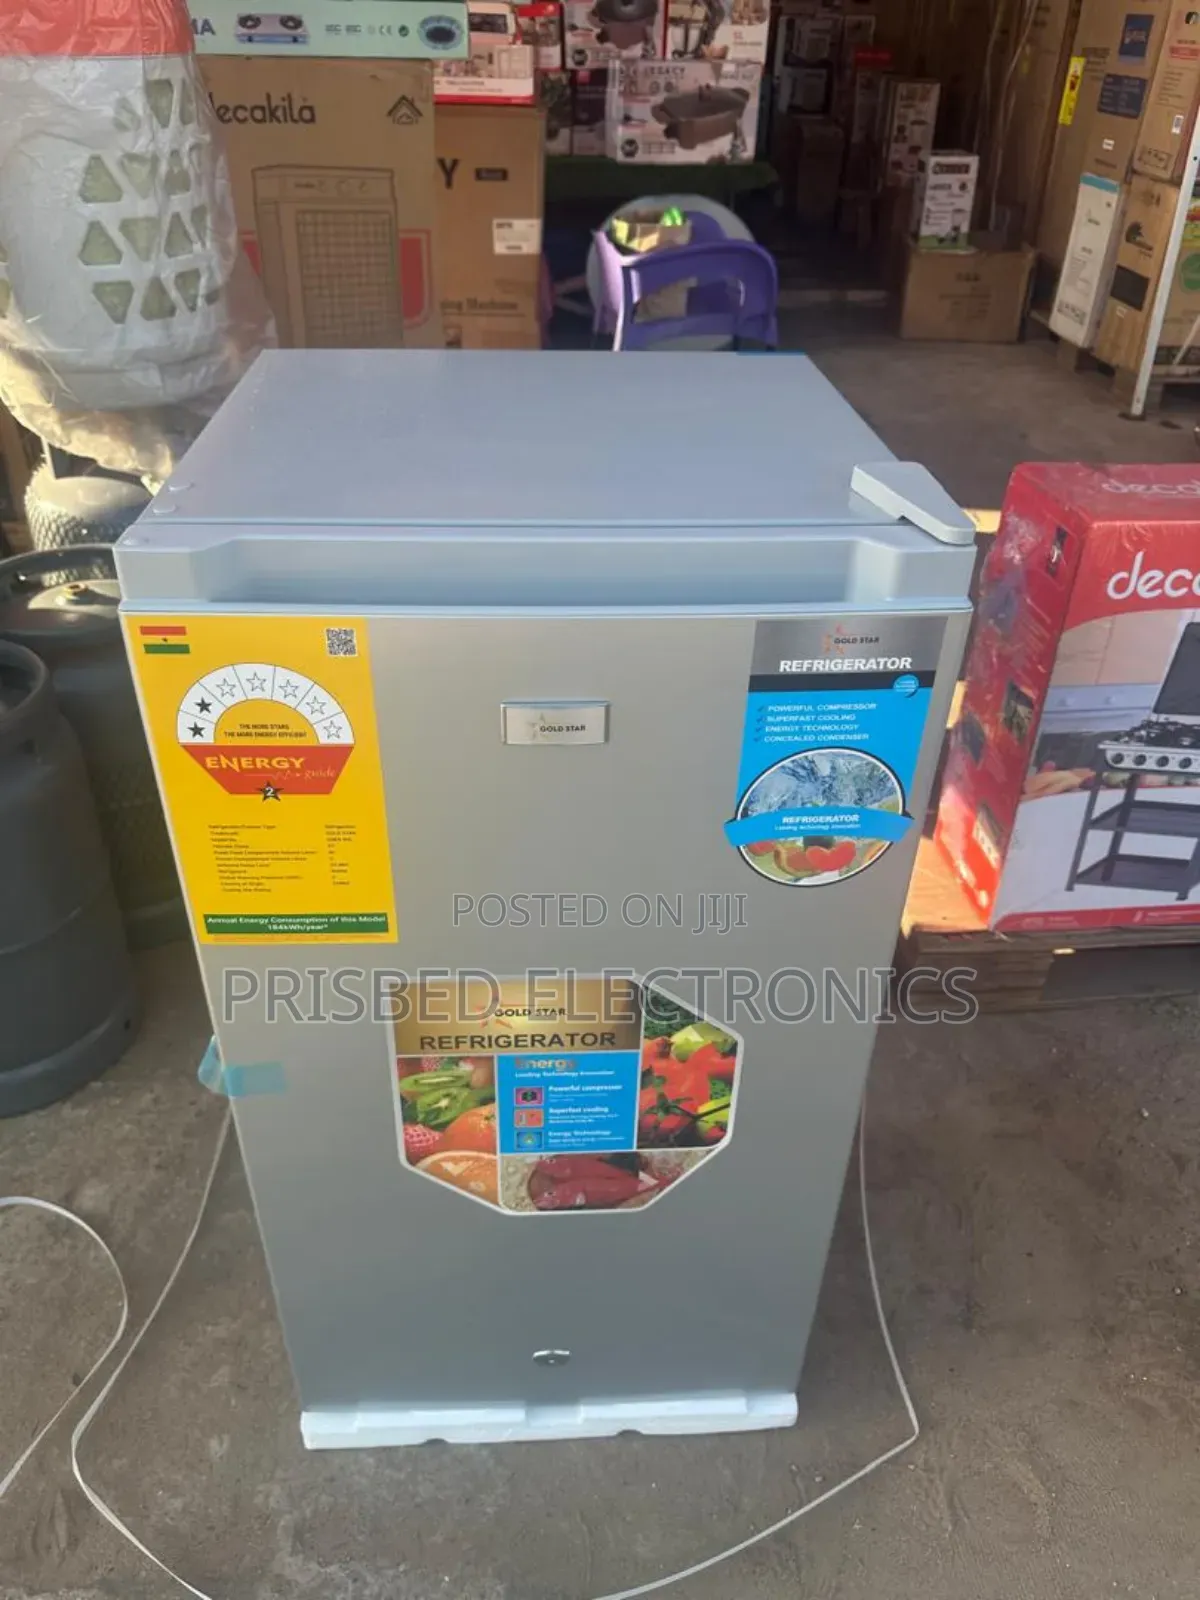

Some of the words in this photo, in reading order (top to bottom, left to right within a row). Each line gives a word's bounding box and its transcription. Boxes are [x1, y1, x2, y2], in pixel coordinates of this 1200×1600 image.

[834, 637, 857, 645] GOLD
[859, 636, 880, 644] STAR
[779, 657, 912, 673] REFRIGERATOR
[768, 704, 814, 712] POWERFUL
[817, 703, 877, 711] COMPRESSOR
[818, 713, 856, 721] COOLING
[802, 724, 859, 732] TECHNOLOGY
[204, 754, 305, 773] ENERGY
[304, 765, 336, 780] guide
[265, 786, 275, 796] 2
[782, 814, 860, 824] REFRIGERATOR
[239, 917, 269, 925] Energy
[270, 916, 329, 925] Consumption
[358, 915, 386, 923] Model
[494, 1007, 532, 1017] GOLD
[535, 1007, 566, 1017] STAR
[420, 1032, 616, 1050] REFRIGERATOR
[583, 1106, 609, 1114] cooling
